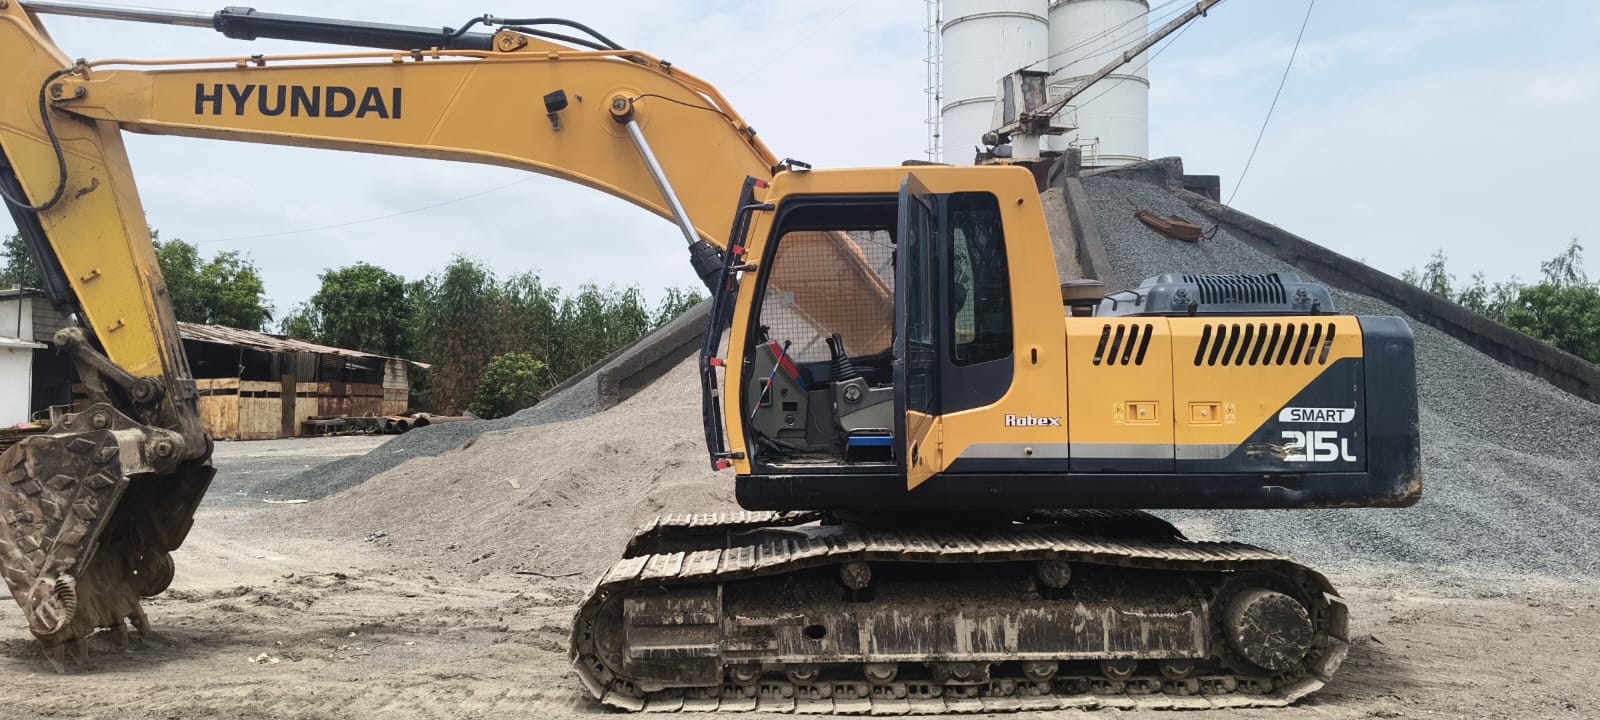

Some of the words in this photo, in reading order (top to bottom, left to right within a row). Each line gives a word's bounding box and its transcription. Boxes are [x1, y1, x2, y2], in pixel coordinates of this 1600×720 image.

[194, 83, 402, 119] HYUNDAI
[1004, 414, 1062, 427] Robex
[1291, 409, 1345, 421] SMART
